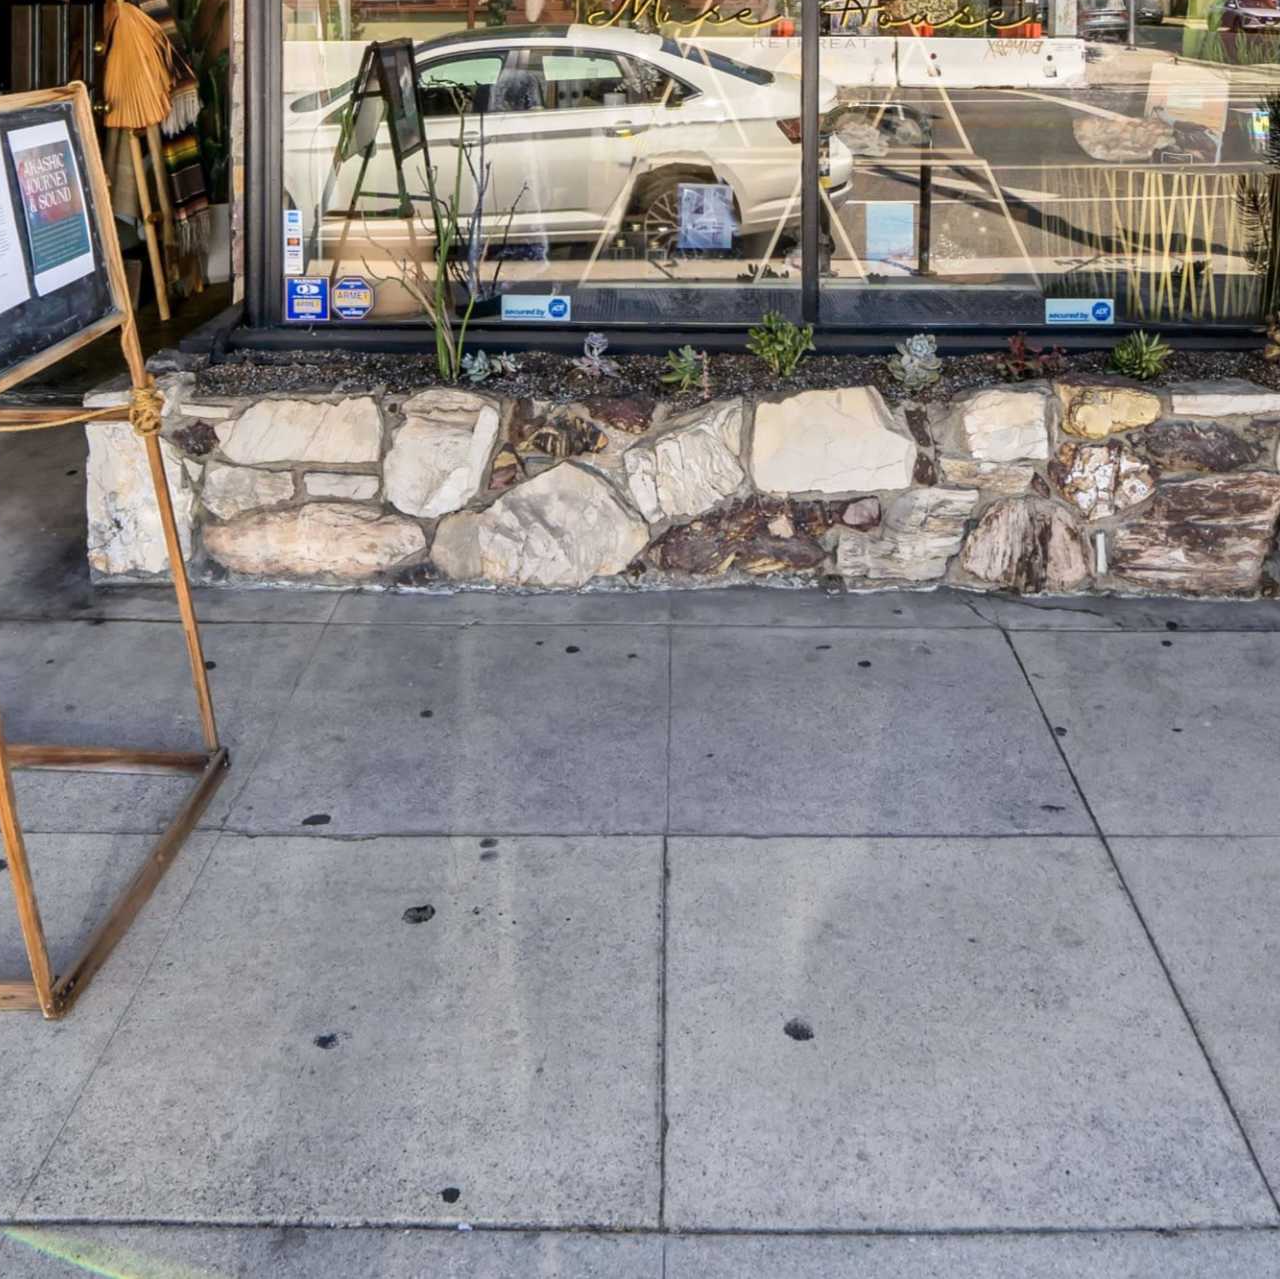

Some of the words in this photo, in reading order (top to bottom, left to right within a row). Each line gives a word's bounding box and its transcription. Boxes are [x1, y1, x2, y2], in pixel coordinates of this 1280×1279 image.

[23, 152, 65, 177] AKASHIC
[25, 170, 69, 195] JOURNEY
[38, 186, 72, 210] SOUND
